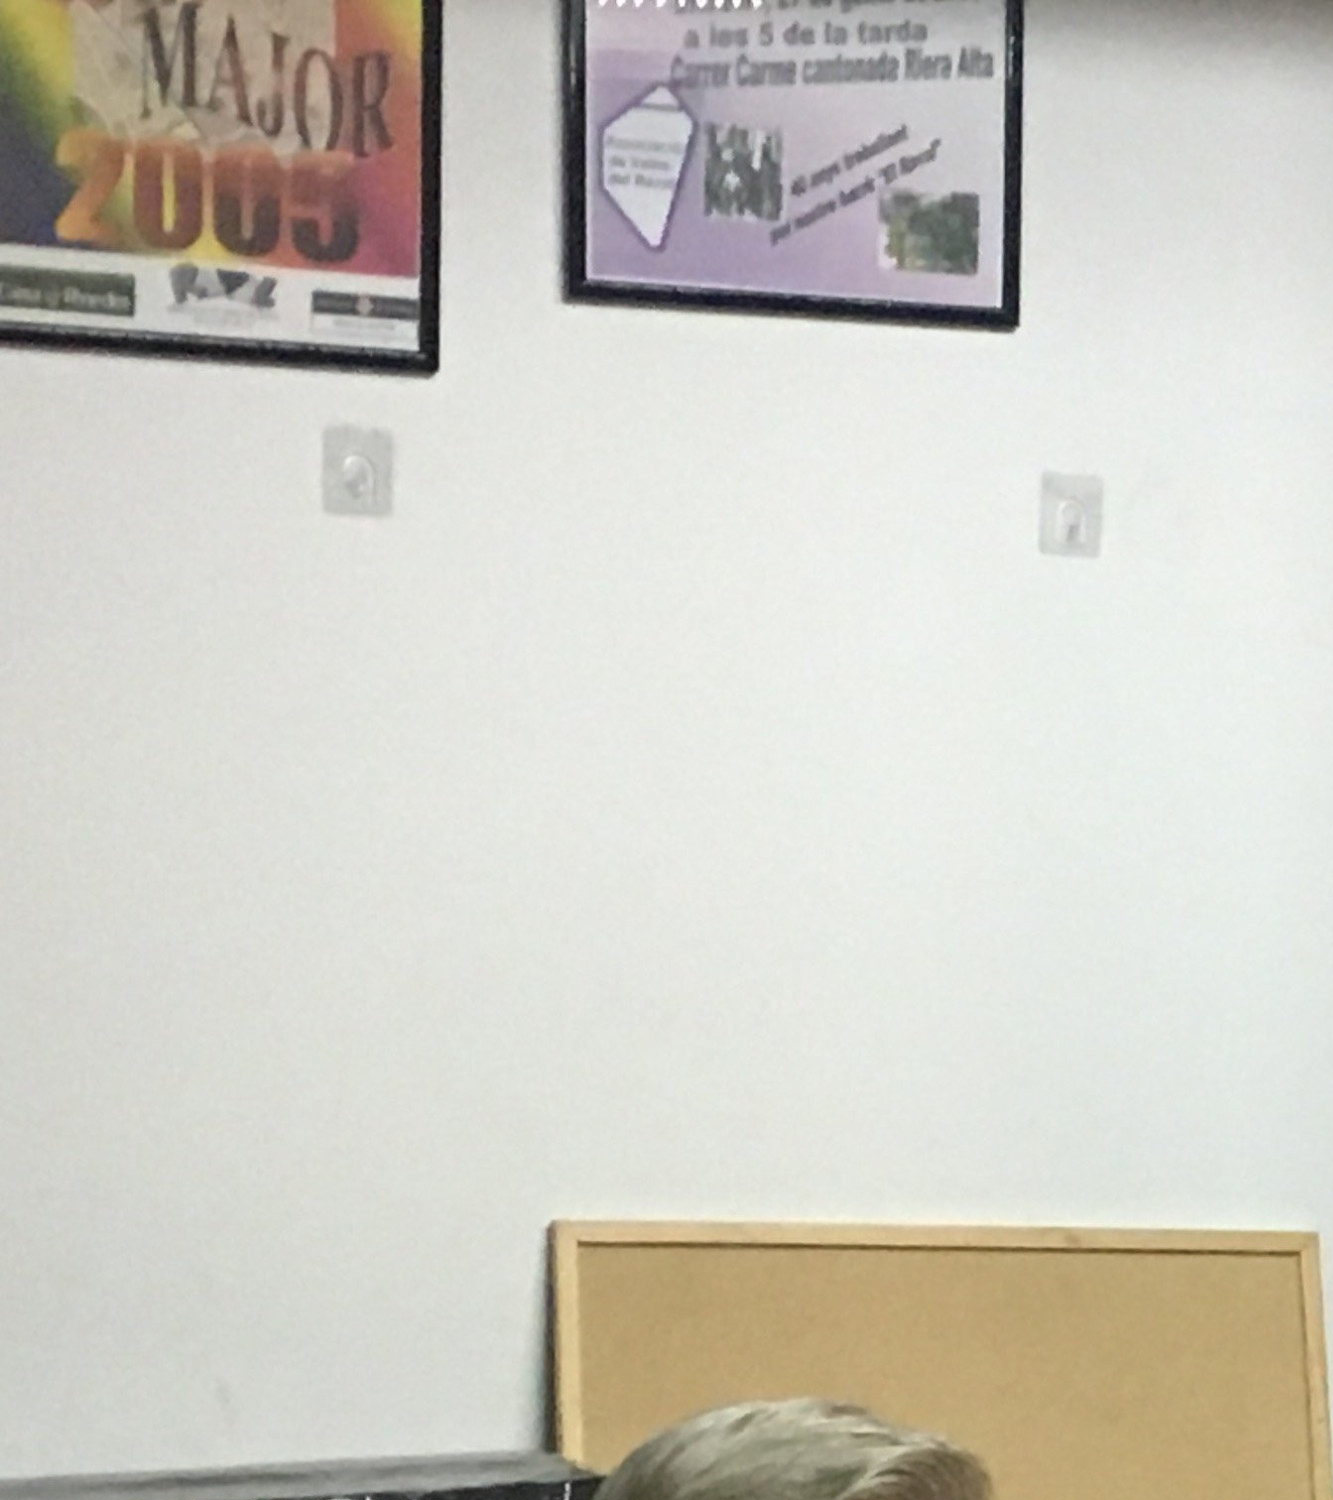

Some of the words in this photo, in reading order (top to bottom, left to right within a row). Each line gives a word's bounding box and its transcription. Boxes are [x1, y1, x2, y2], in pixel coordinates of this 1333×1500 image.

[139, 1, 395, 157] MAJOR
[858, 19, 928, 44] tarda
[54, 128, 361, 263] 2005
